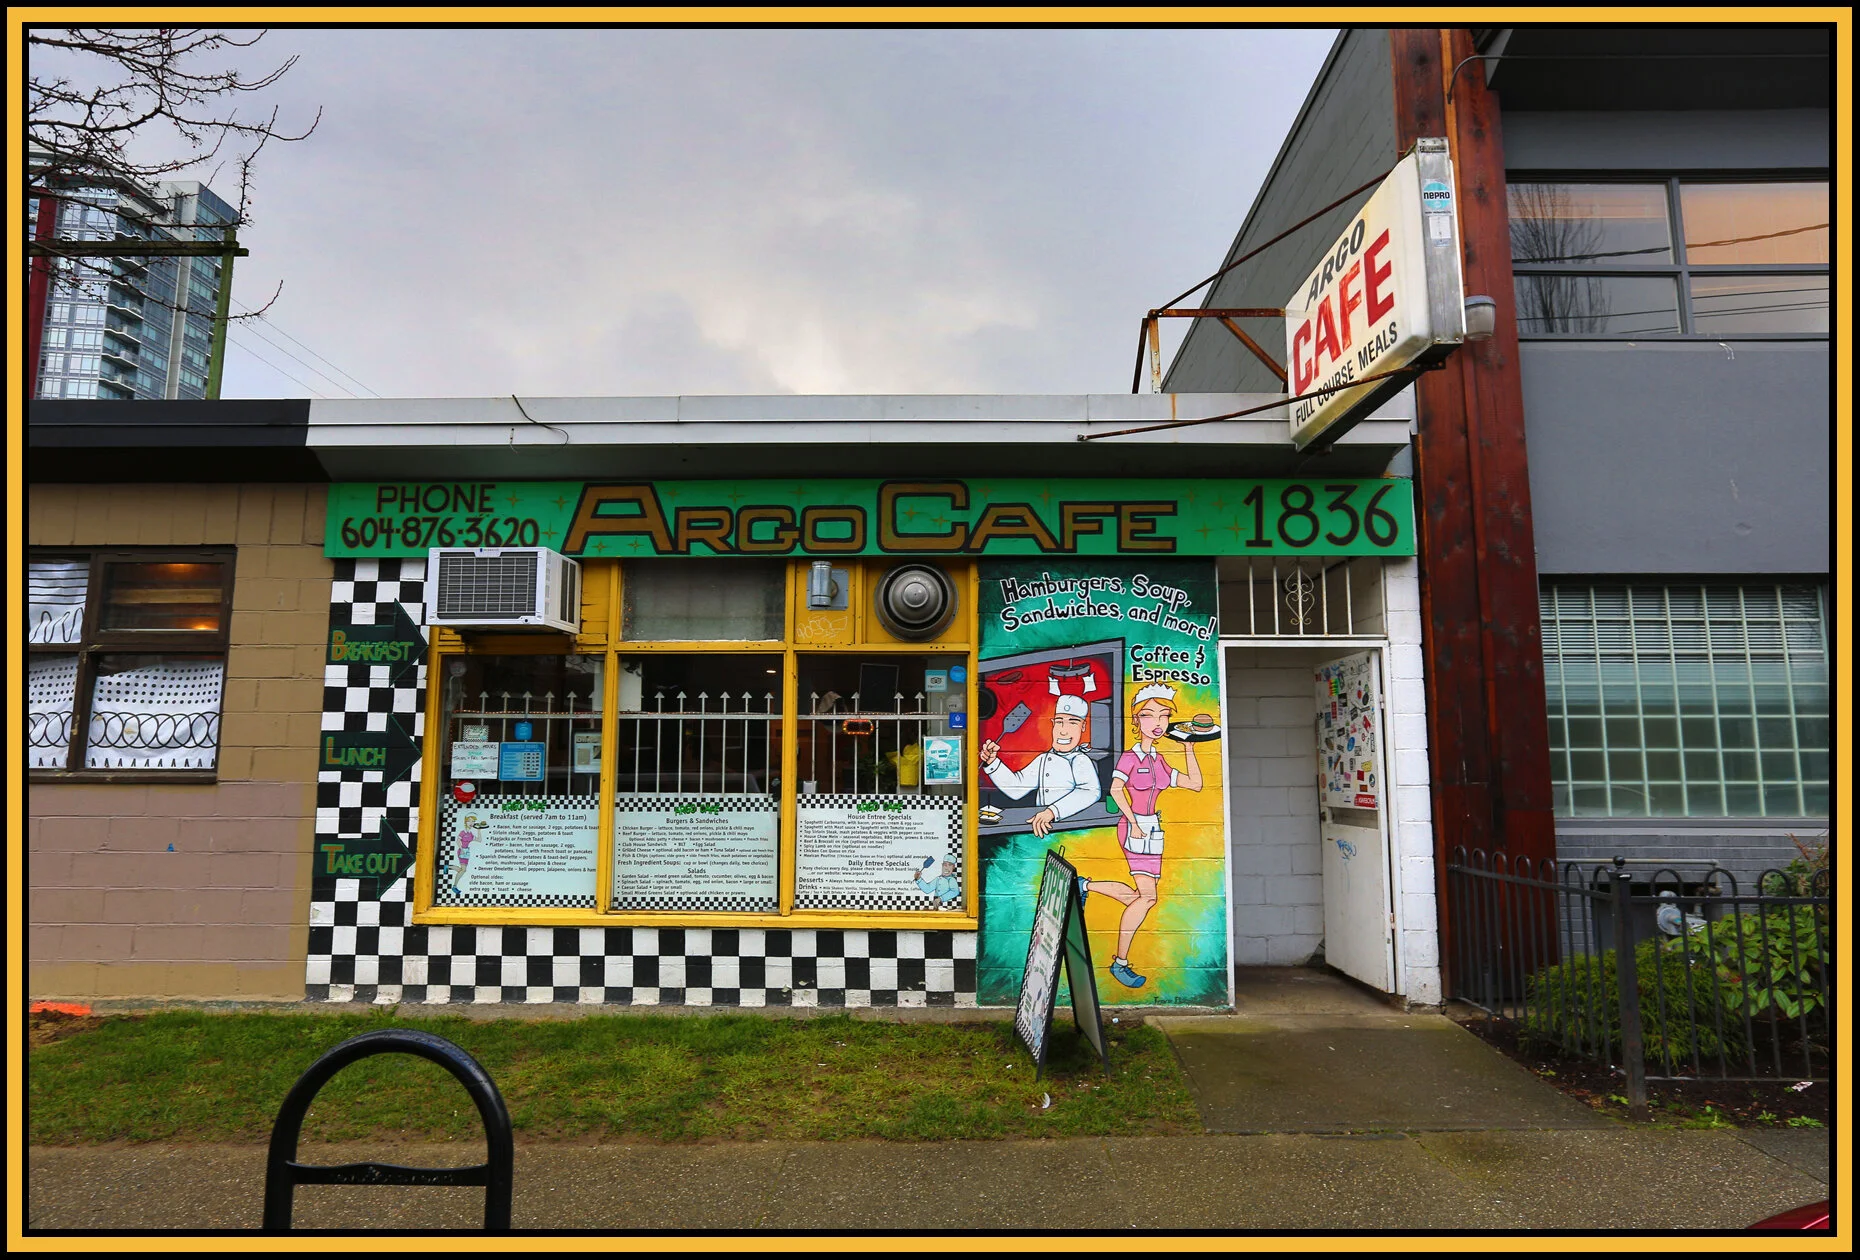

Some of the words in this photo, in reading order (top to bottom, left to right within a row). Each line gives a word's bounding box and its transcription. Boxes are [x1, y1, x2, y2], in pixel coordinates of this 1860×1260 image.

[1305, 218, 1366, 312] ARGO
[1292, 227, 1395, 397] CAFE
[1296, 397, 1315, 427] FULL
[1317, 359, 1355, 407] COURSE
[1357, 321, 1398, 371] MEALS
[376, 484, 496, 513] PHONE
[1243, 484, 1400, 549] 1836
[1000, 573, 1126, 604] Hamburgers,
[1132, 574, 1193, 612] Soup,
[1001, 599, 1124, 631] Sandwiches,
[1128, 604, 1162, 624] and
[1163, 616, 1217, 641] more!
[331, 630, 414, 661] BREAKFAST
[1130, 644, 1189, 664] Coffee
[1132, 664, 1211, 685] Espresso
[326, 736, 386, 765] LUNCH
[520, 813, 542, 821] (served
[321, 844, 364, 874] TAKE
[366, 853, 403, 874] OUT
[885, 860, 910, 868] Specials
[1042, 863, 1068, 923] OPEN
